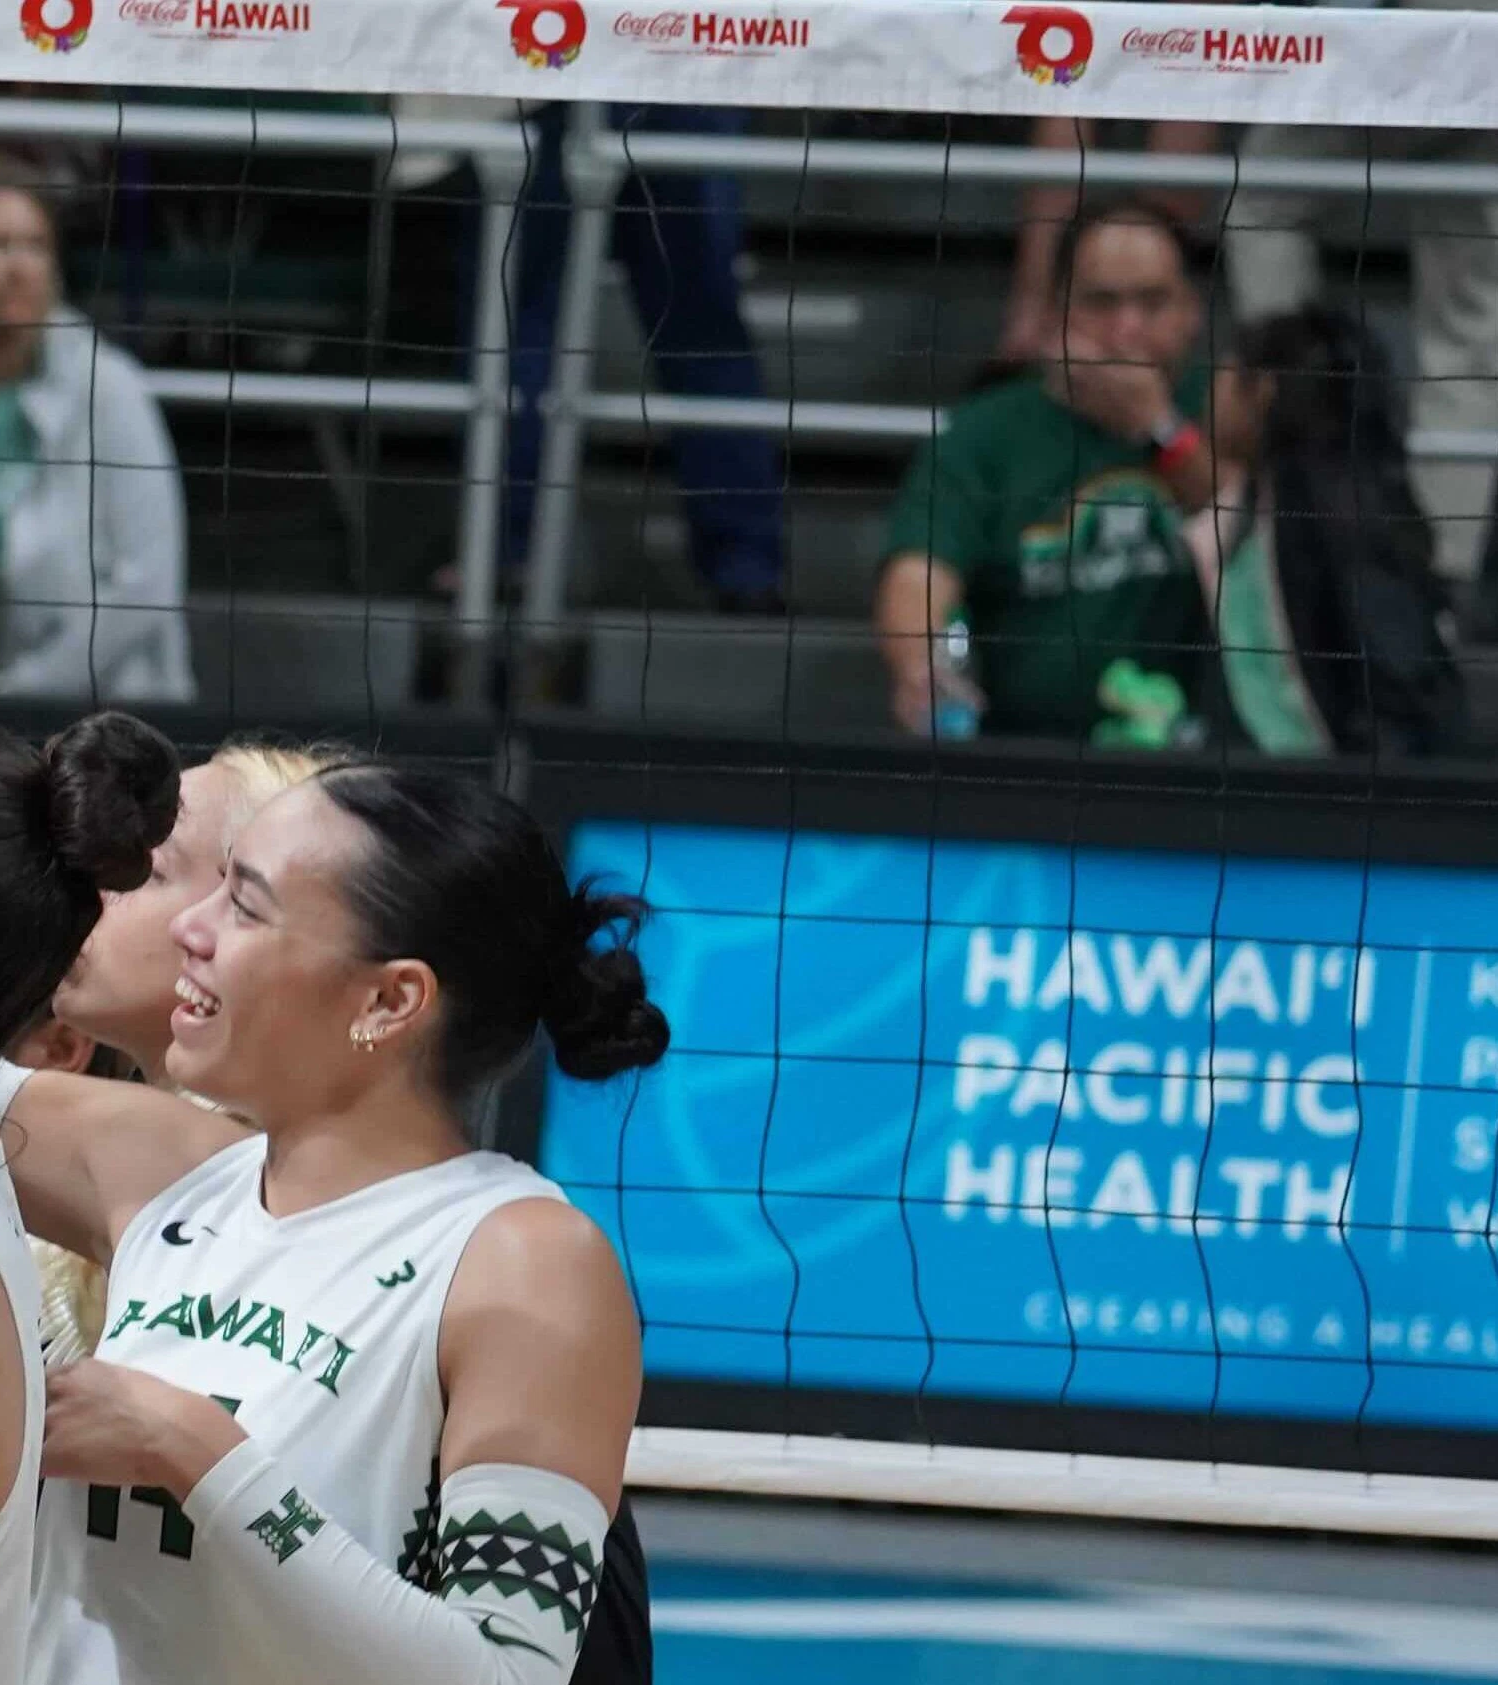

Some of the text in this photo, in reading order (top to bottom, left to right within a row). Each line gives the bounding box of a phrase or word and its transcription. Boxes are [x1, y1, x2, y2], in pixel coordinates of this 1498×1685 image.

[195, 0, 310, 31] HAWAII
[693, 12, 810, 47] HAWAII
[1203, 29, 1324, 64] HAWAII
[953, 1034, 1364, 1138] PACIFIC
[942, 1141, 1355, 1246] HEALTH
